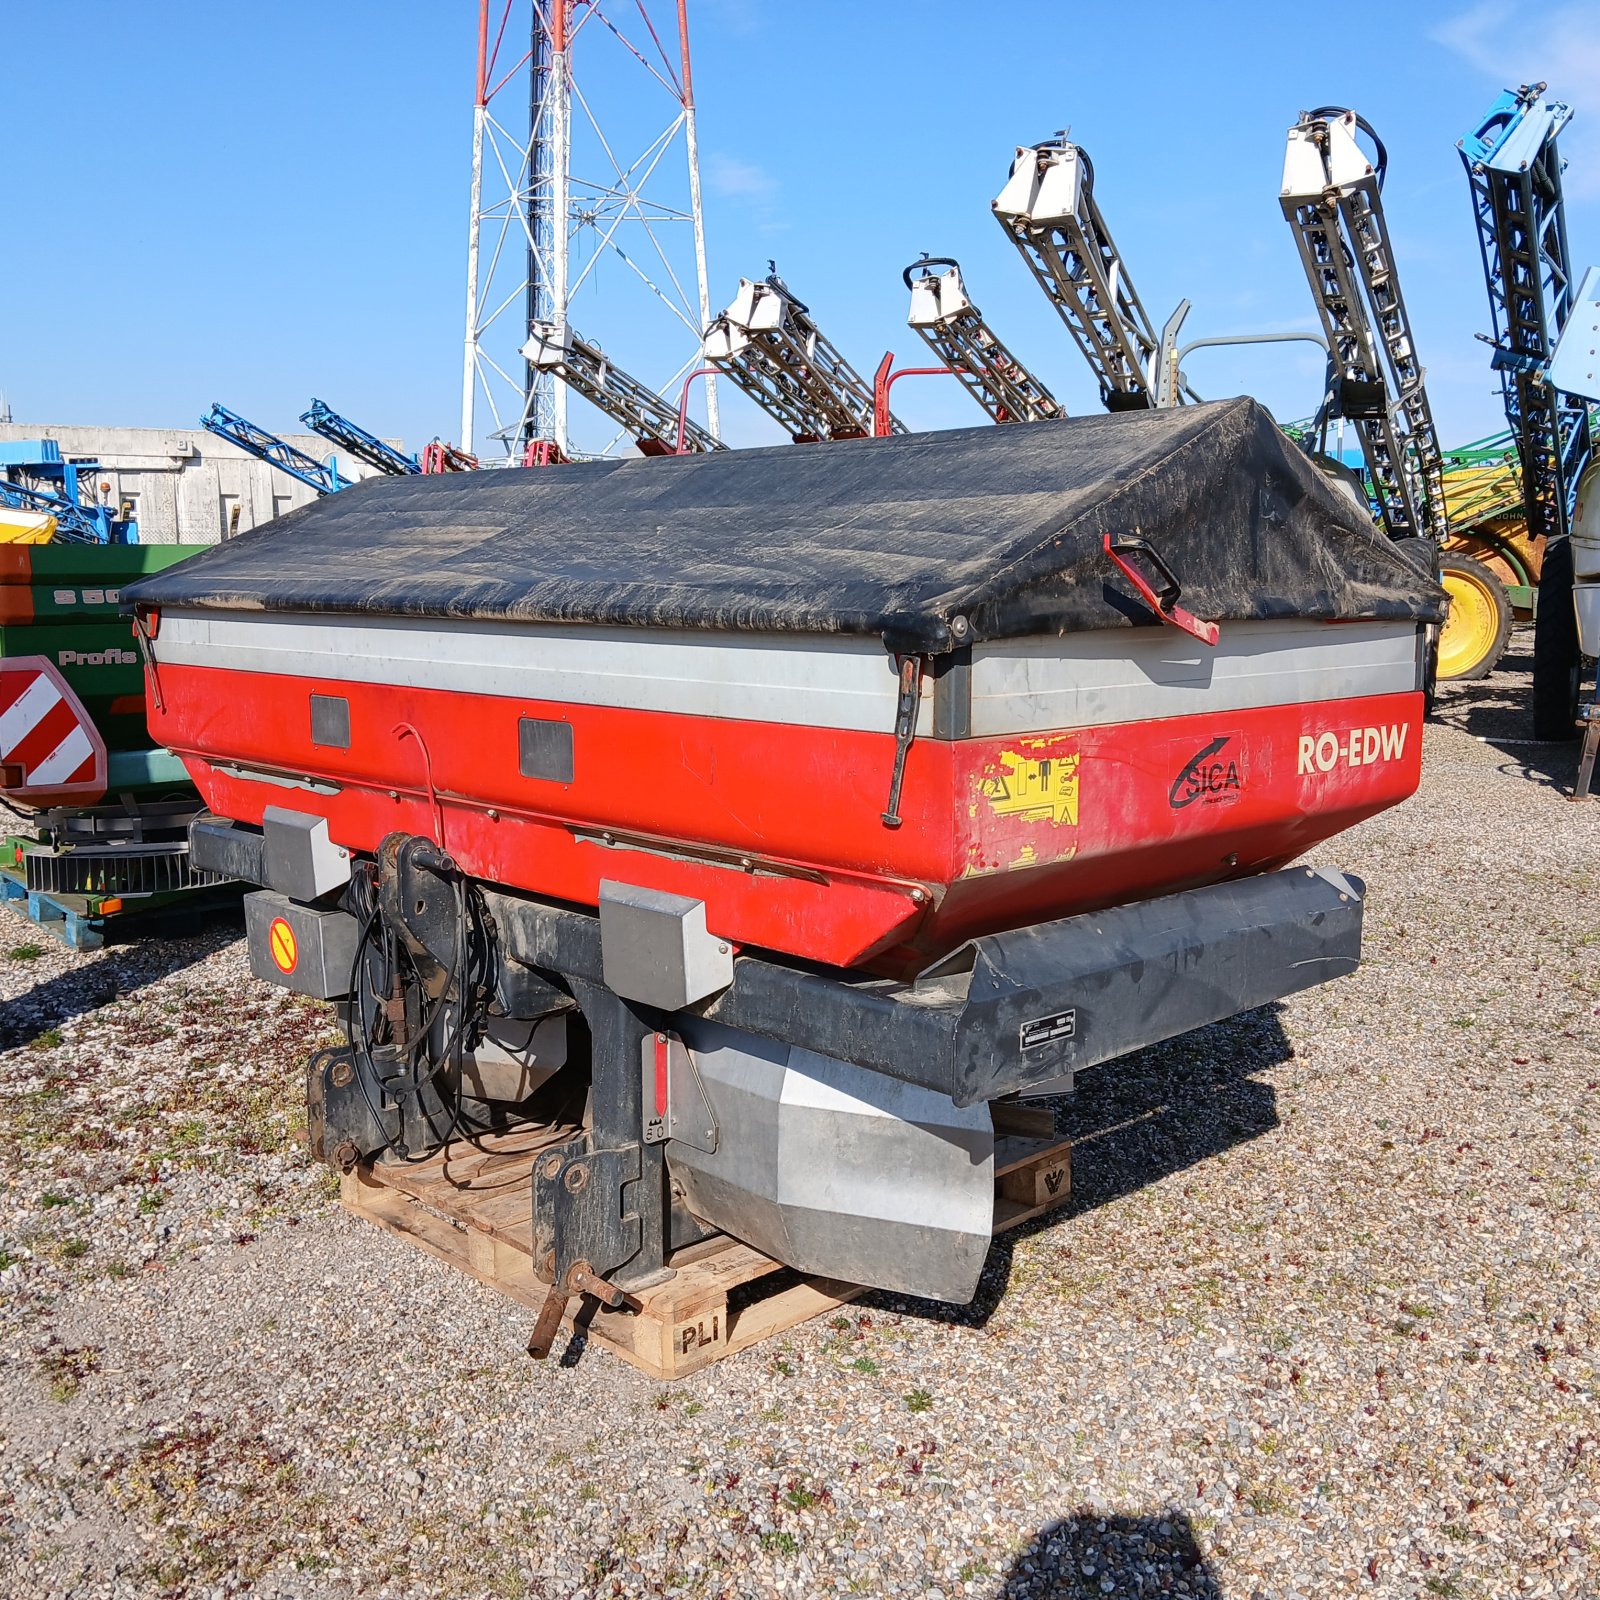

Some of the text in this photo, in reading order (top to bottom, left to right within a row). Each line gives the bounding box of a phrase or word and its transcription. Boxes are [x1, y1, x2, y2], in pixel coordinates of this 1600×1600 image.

[53, 589, 77, 605] S
[58, 648, 137, 667] Profis
[1297, 722, 1409, 775] RO-EDW
[1185, 760, 1240, 798] SICA
[682, 1315, 719, 1354] PLI
